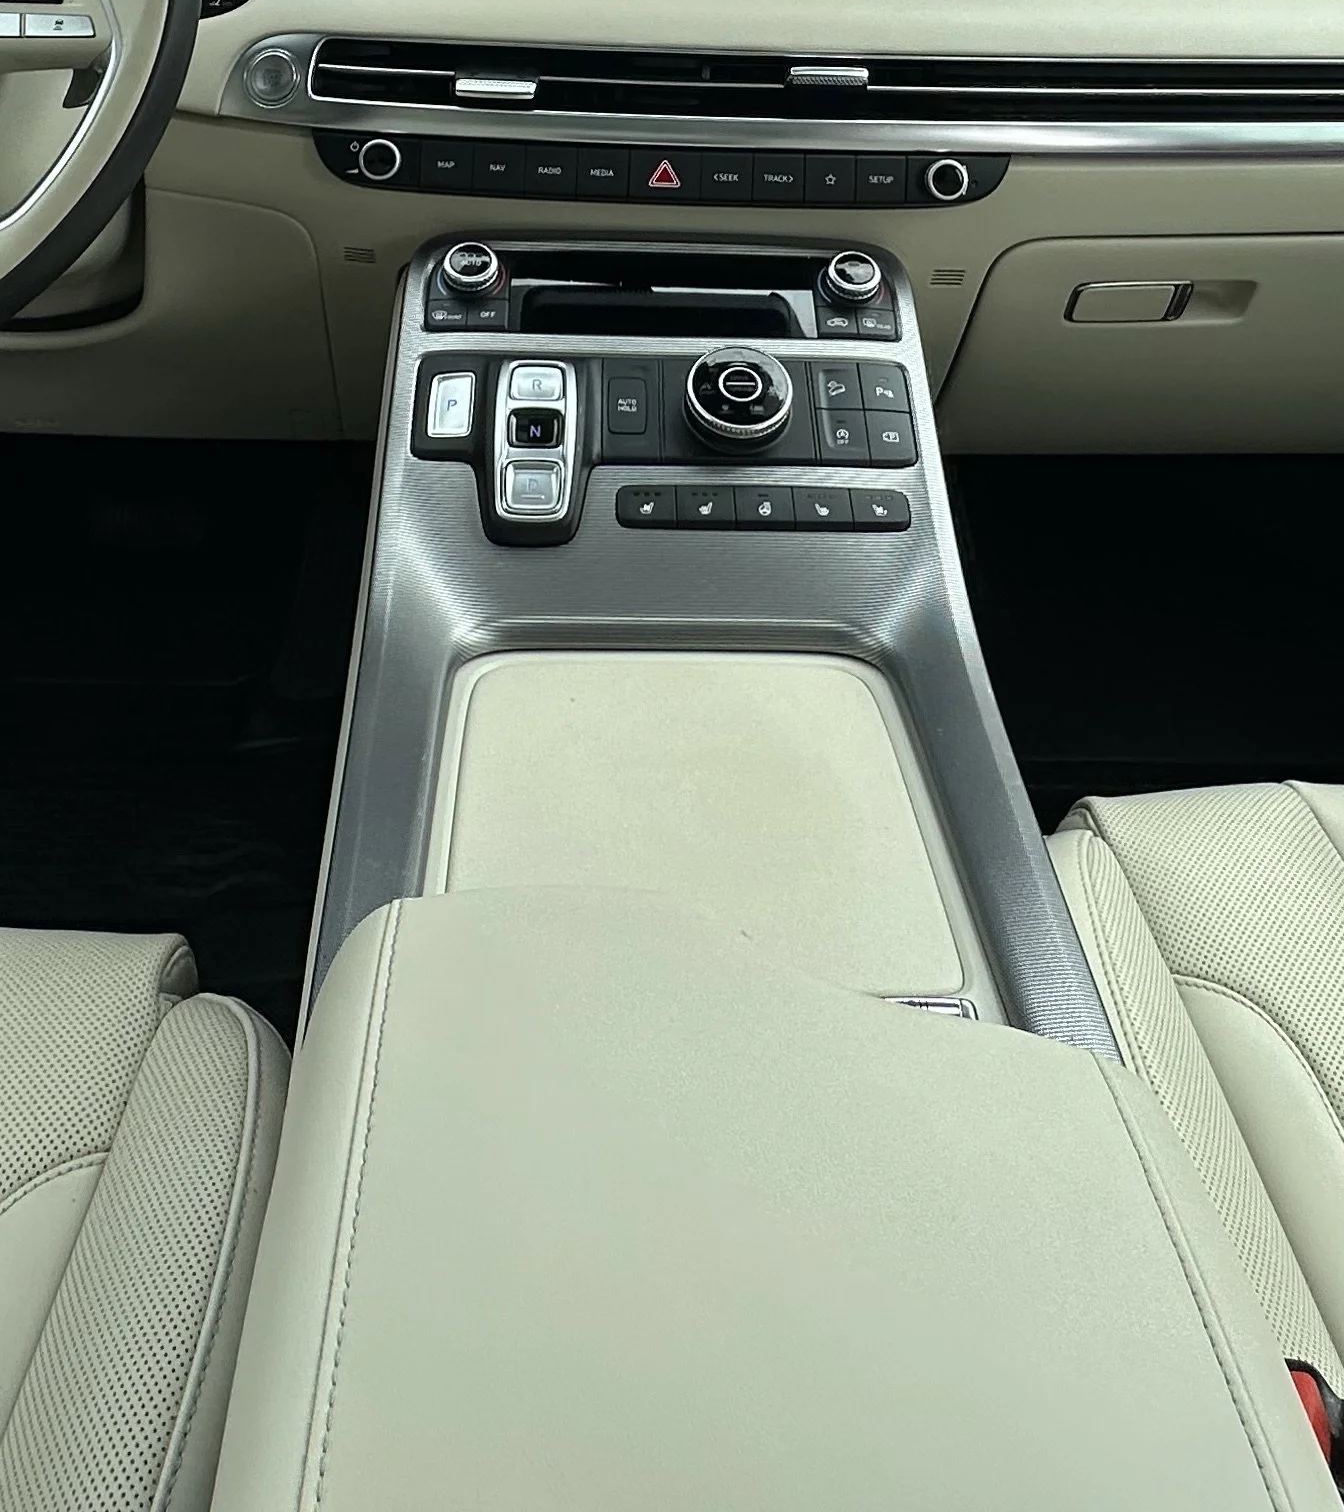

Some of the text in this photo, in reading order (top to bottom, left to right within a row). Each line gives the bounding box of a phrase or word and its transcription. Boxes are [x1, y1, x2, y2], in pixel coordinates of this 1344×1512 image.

[437, 159, 455, 169] MAP
[489, 163, 506, 172] NAV
[537, 166, 562, 176] RADIO
[590, 168, 615, 178] MEDIA
[868, 175, 894, 184] SETUP
[480, 310, 496, 318] OFF
[532, 378, 542, 391] R
[446, 399, 457, 411] P
[618, 398, 637, 406] AUTO
[530, 425, 541, 438] N
[527, 477, 538, 491] D
